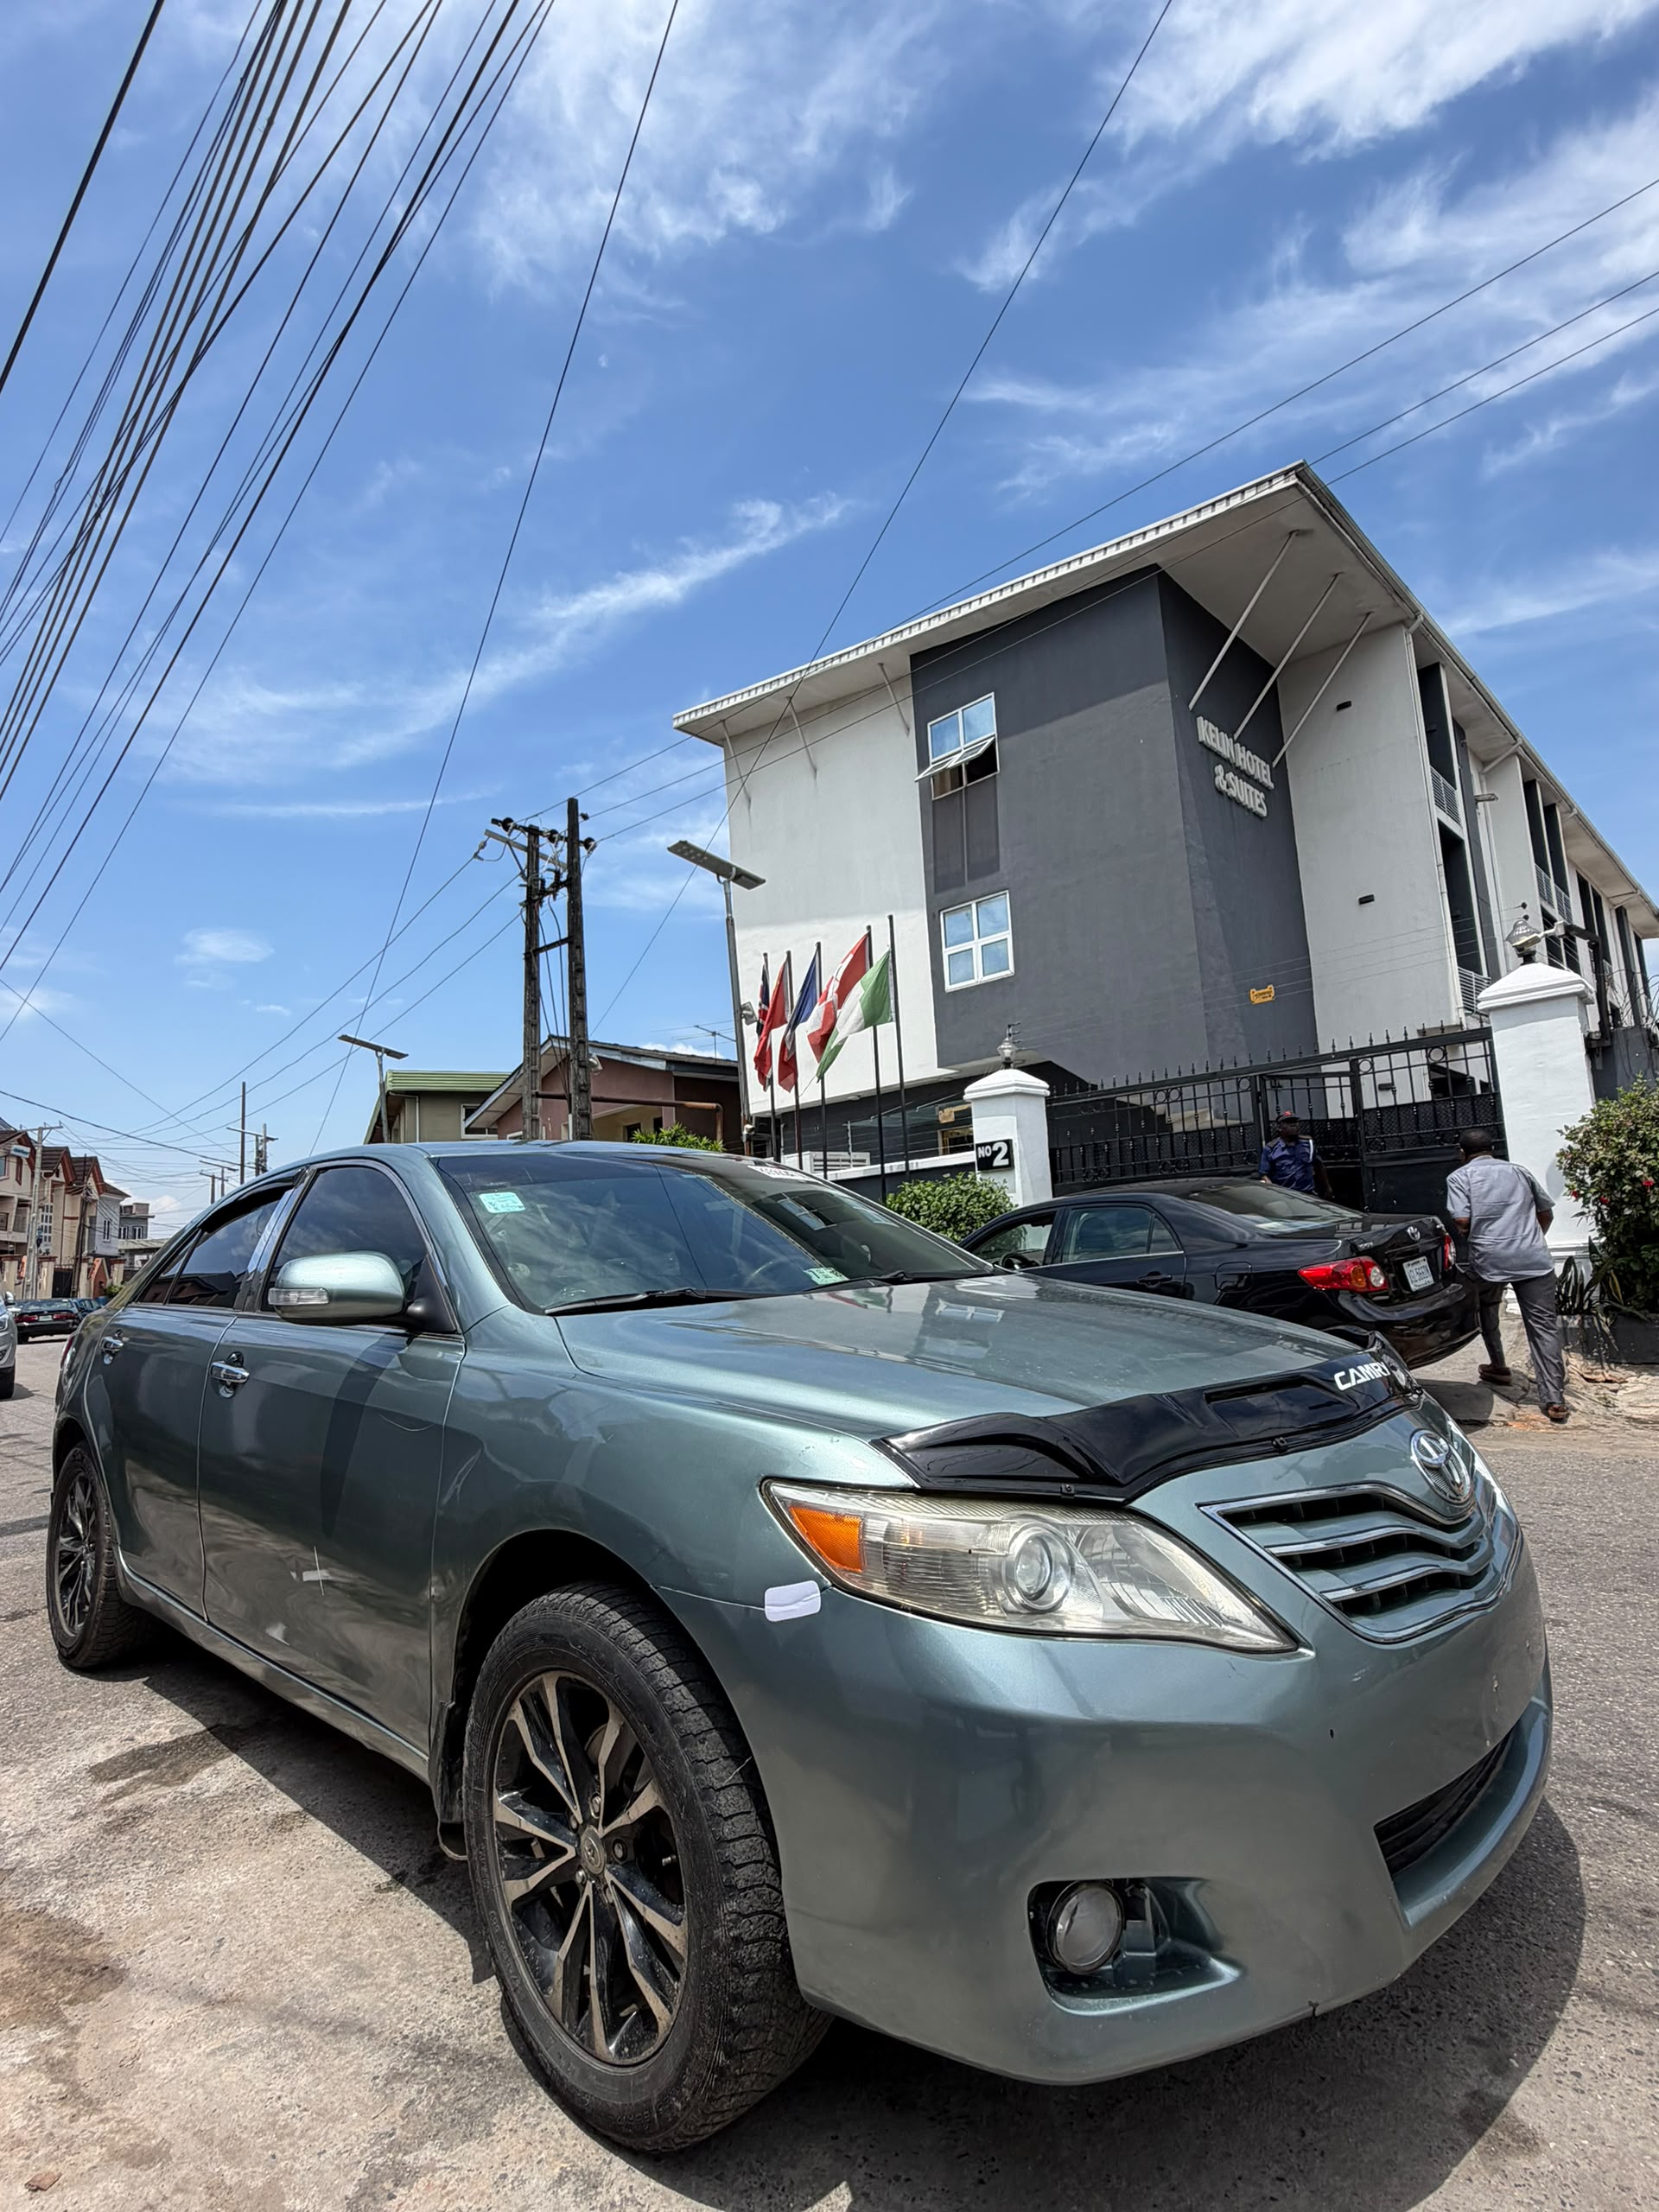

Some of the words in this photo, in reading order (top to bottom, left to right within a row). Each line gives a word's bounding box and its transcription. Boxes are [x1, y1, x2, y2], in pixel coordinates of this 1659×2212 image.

[1197, 716, 1235, 764] KELIN
[1235, 742, 1274, 790] HOTEL
[1225, 772, 1268, 817] SUITES
[977, 1145, 992, 1159] NO
[992, 1141, 1009, 1166] 2
[1333, 1361, 1391, 1391] CAMRY
